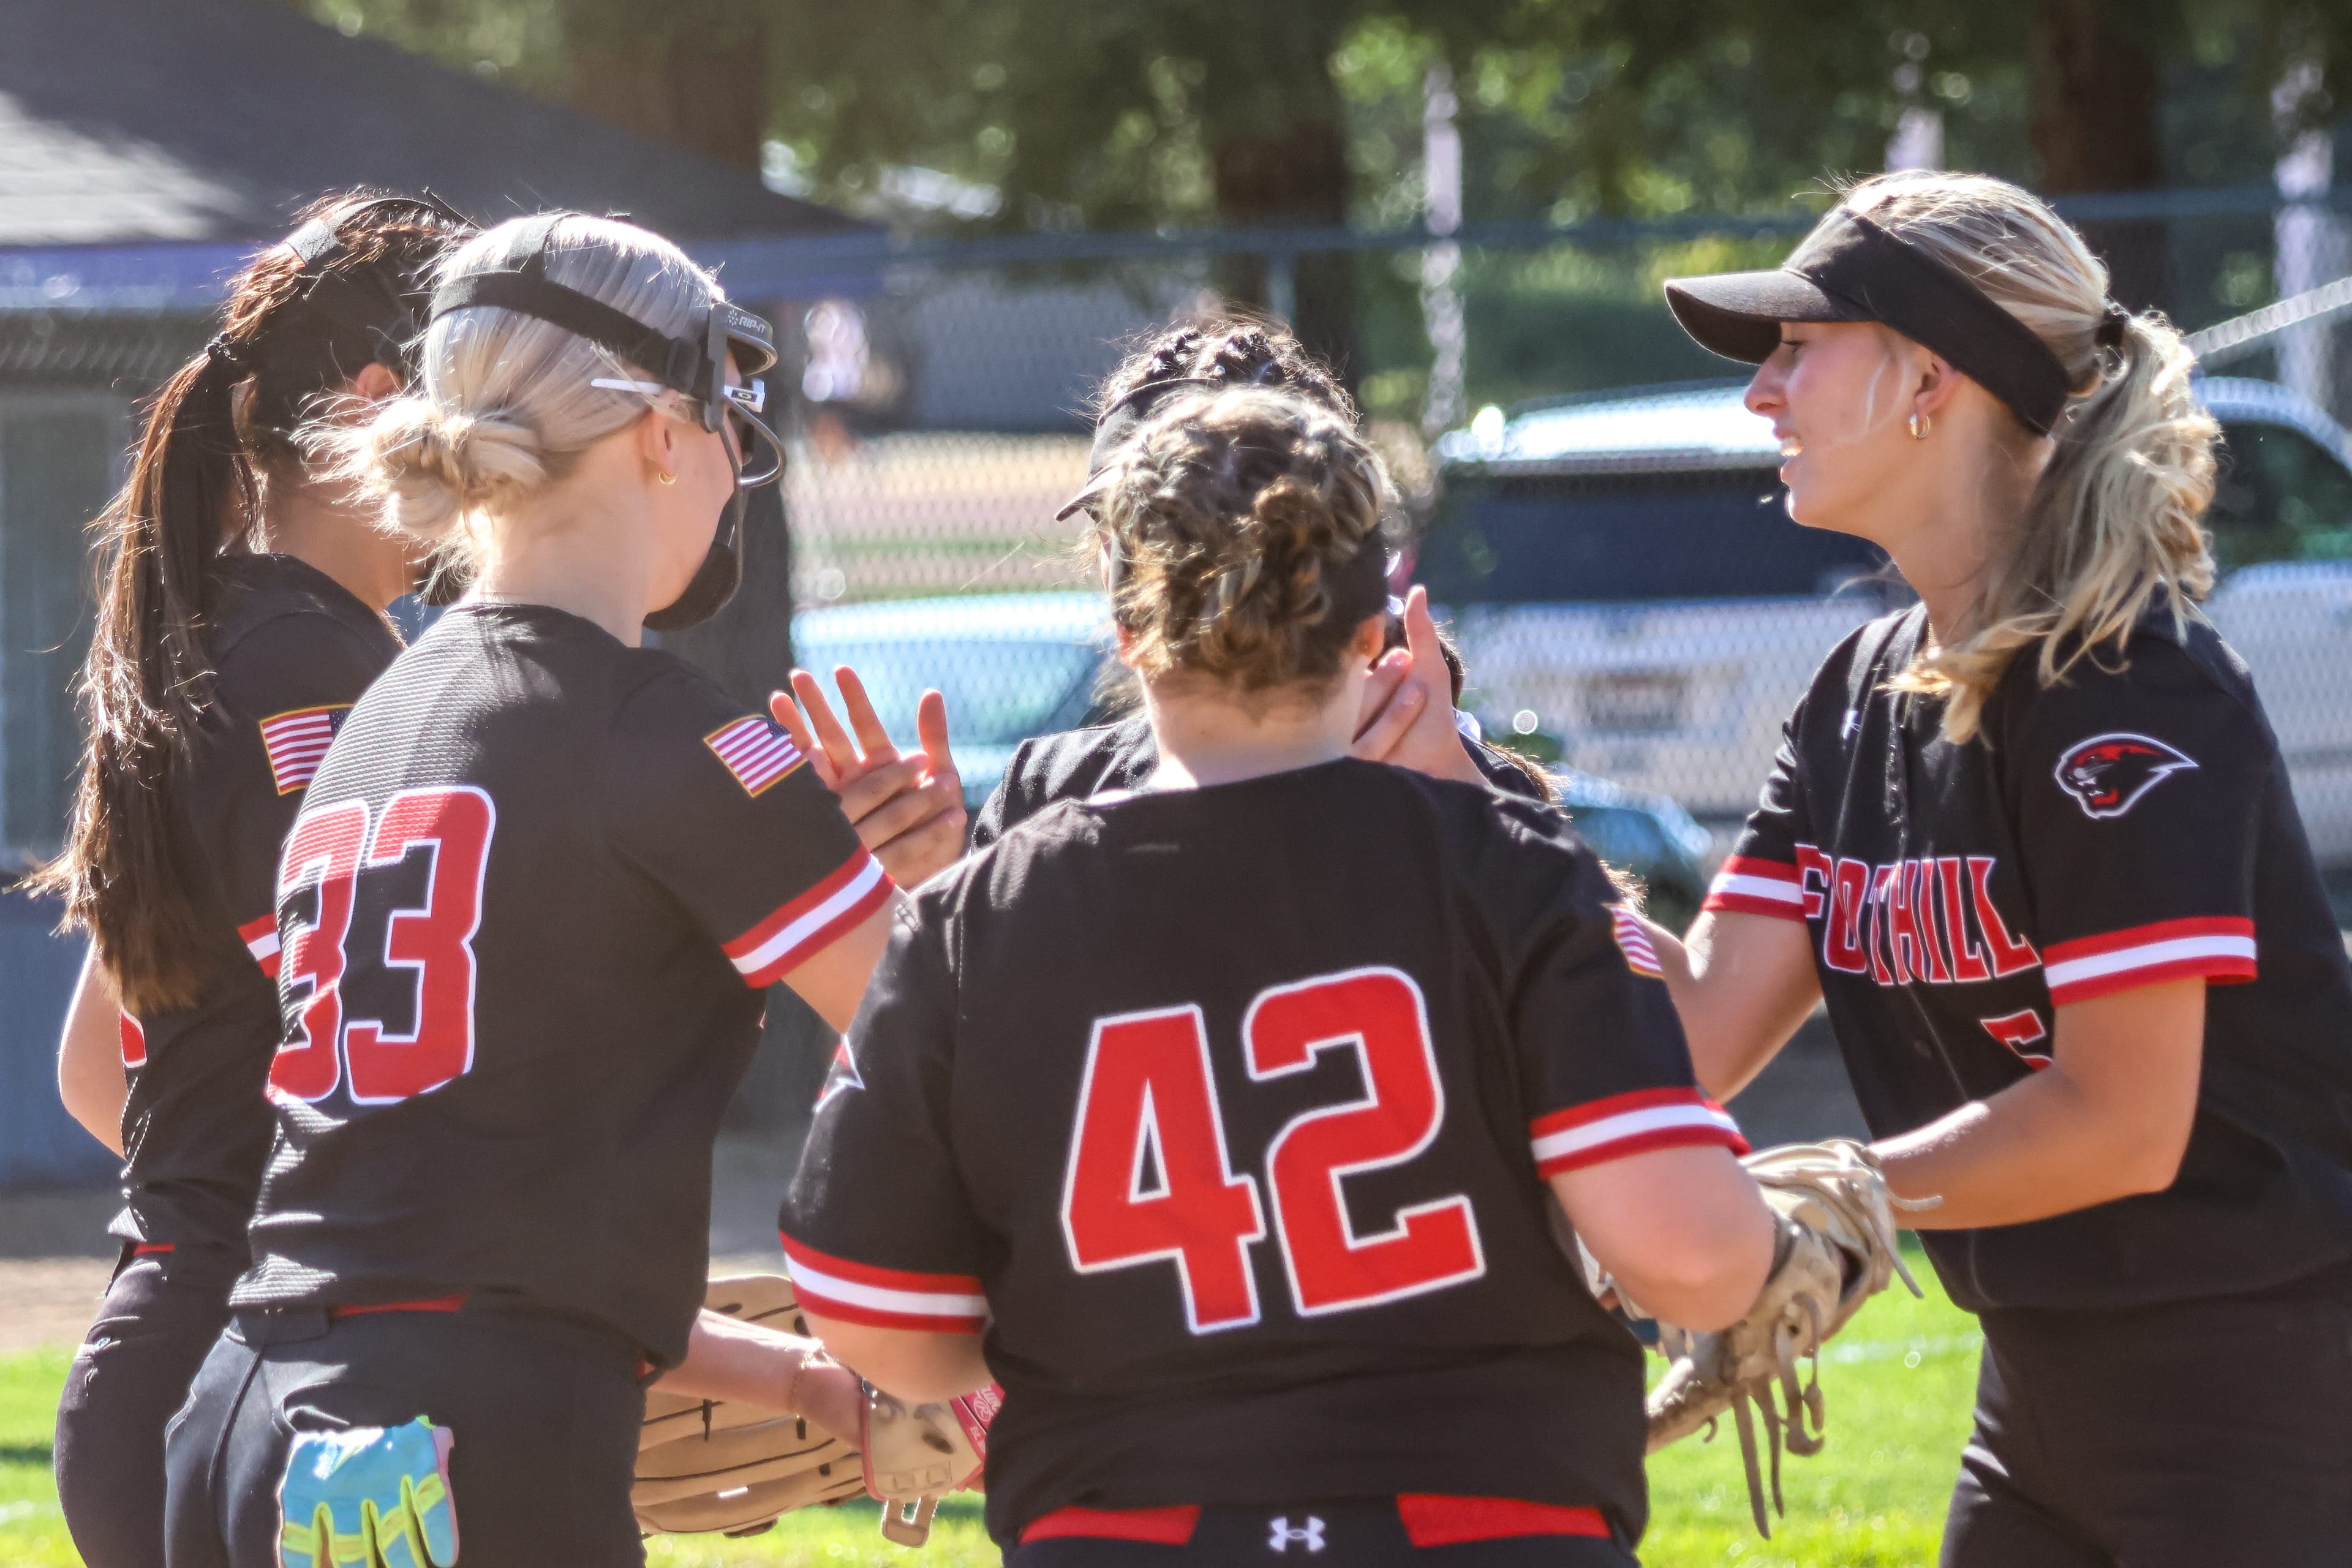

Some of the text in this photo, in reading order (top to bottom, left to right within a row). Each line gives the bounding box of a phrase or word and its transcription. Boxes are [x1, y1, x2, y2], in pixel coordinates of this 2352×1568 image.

[265, 785, 497, 1107] 33
[1794, 842, 2042, 986] FOTHILL
[1061, 965, 1487, 1335] 42
